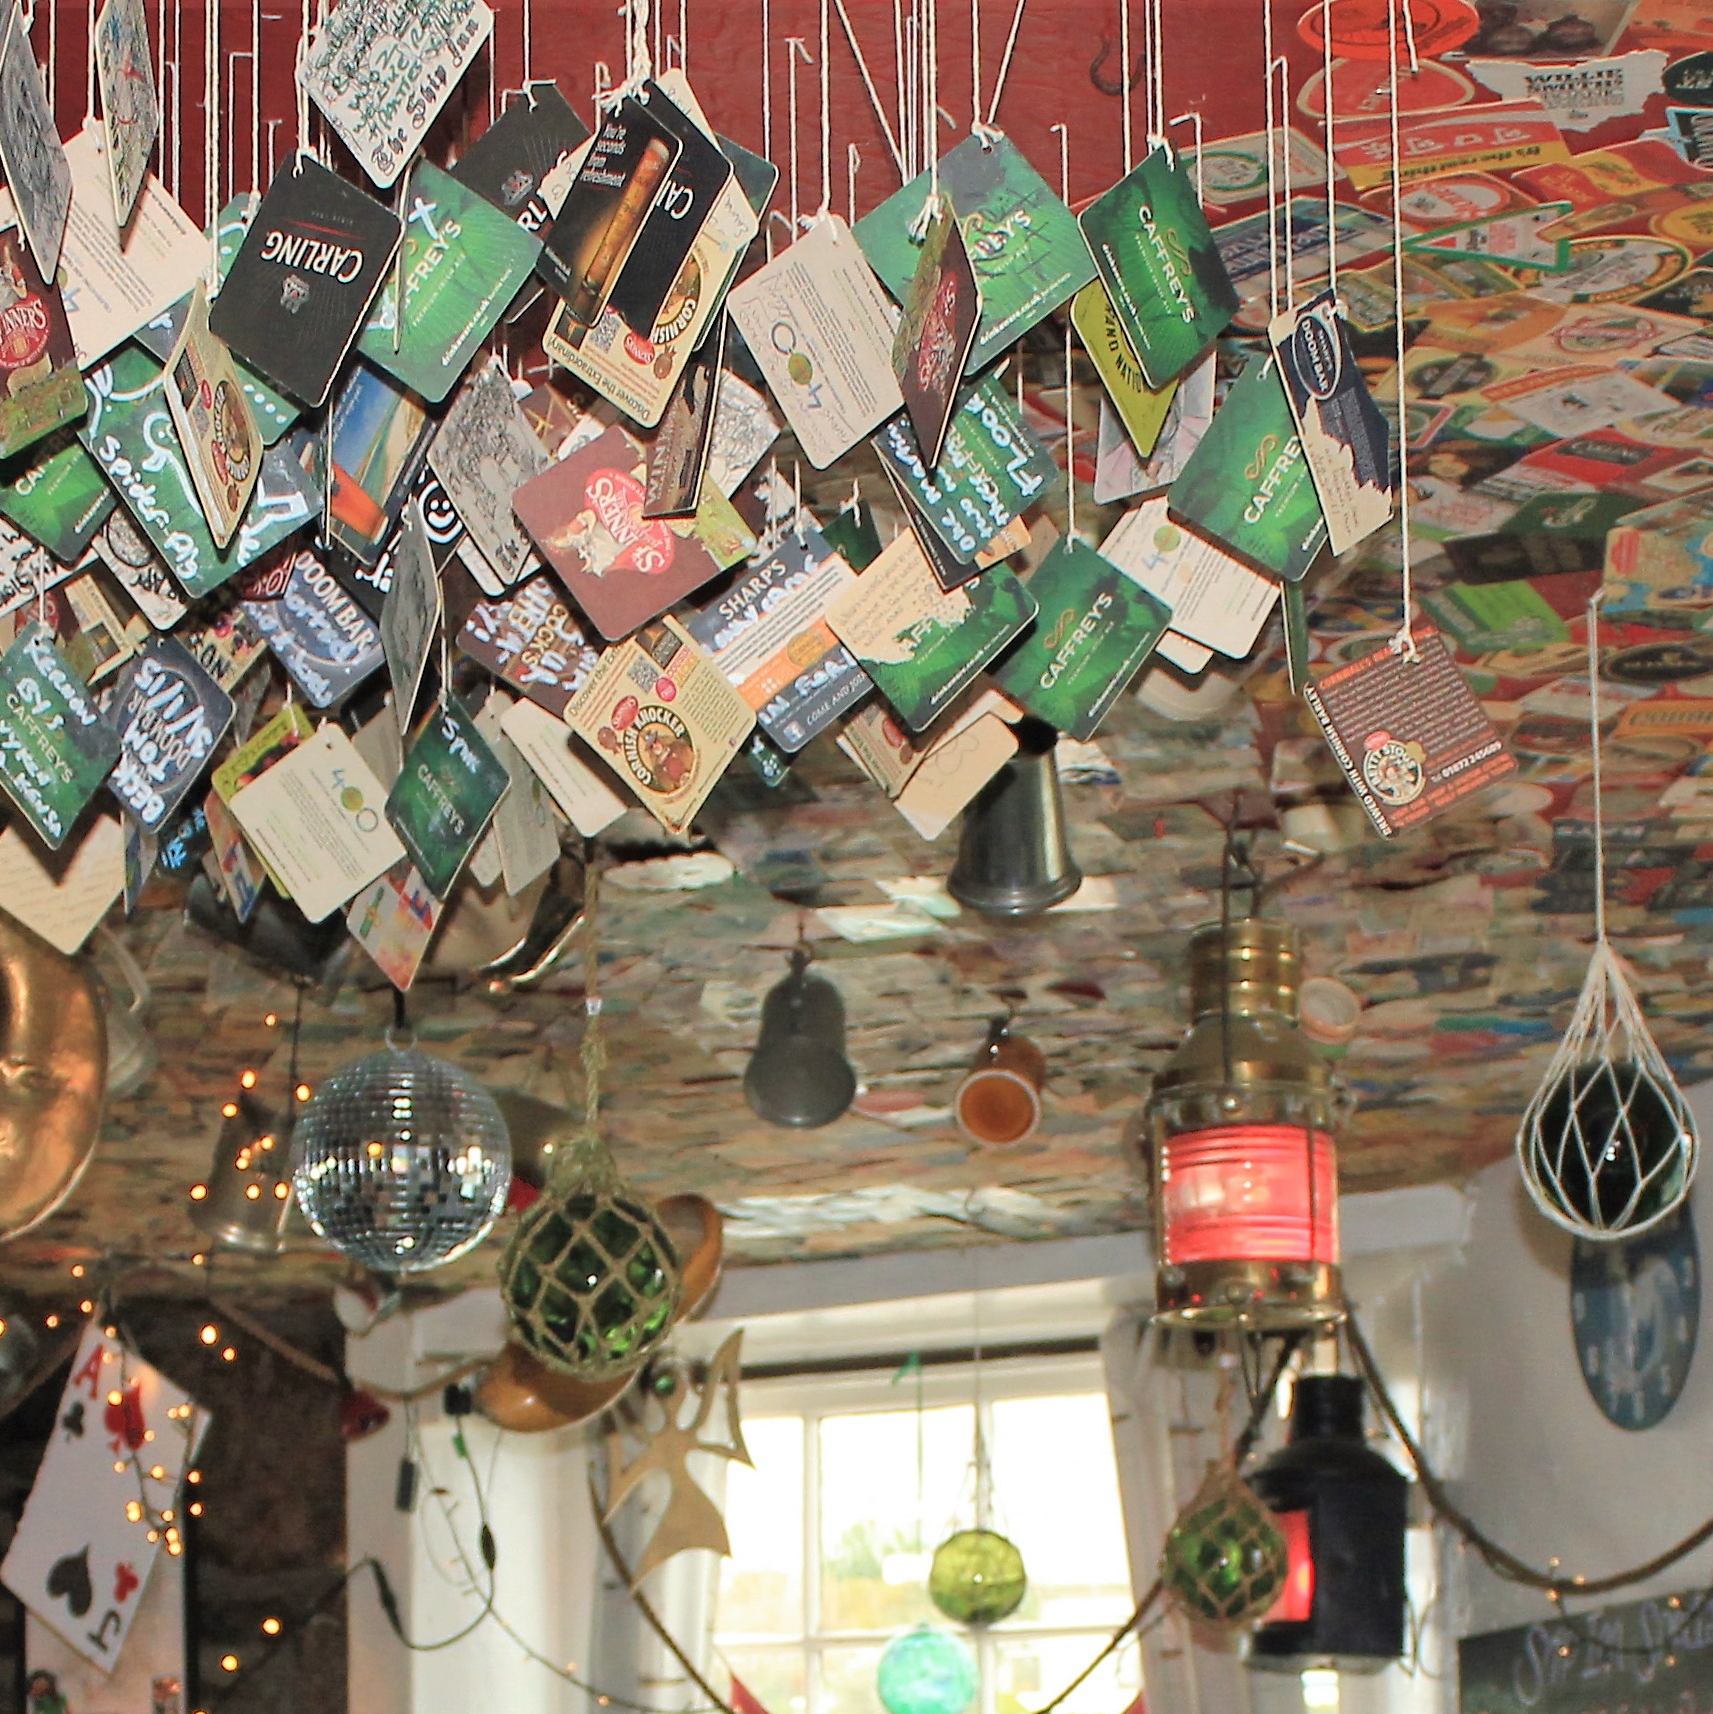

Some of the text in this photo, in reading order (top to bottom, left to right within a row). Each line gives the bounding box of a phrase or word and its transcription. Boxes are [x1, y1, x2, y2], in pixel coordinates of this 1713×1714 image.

[260, 229, 365, 284] CARLING
[1138, 204, 1196, 324] CAFFREY'S
[1242, 434, 1305, 526] CAFFRE
[718, 557, 787, 622] SHARP'S
[1038, 591, 1115, 693] CAFFREY'S
[5, 694, 75, 785] CAFFREY'S
[633, 705, 687, 740] KNOCKER
